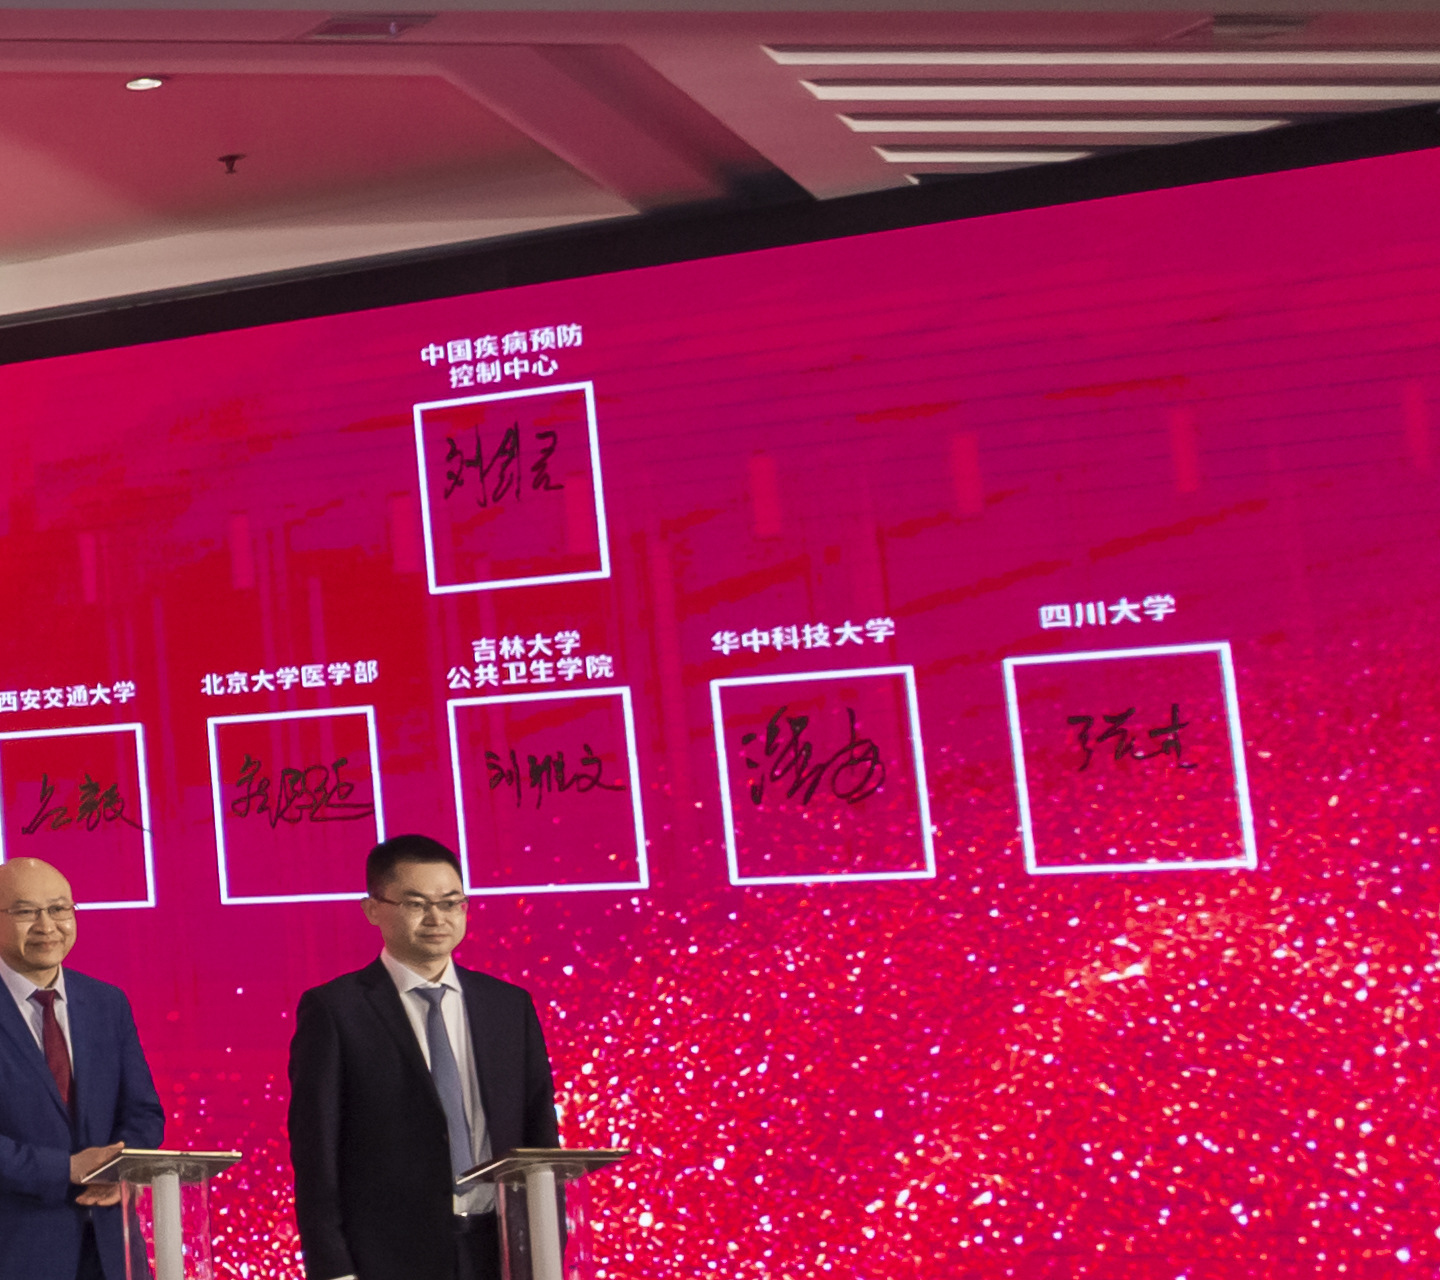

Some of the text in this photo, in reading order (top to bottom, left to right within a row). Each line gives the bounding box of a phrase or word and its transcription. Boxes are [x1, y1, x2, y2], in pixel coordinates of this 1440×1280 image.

[420, 323, 583, 366] 中国疾病预防
[449, 354, 559, 389] 控制中心
[1038, 594, 1178, 629] 四川大学
[471, 630, 581, 662] 吉林大学
[710, 617, 897, 655] 华中科技大学
[200, 659, 380, 697] 北京大学医学部
[446, 653, 615, 689] 公共卫生学院
